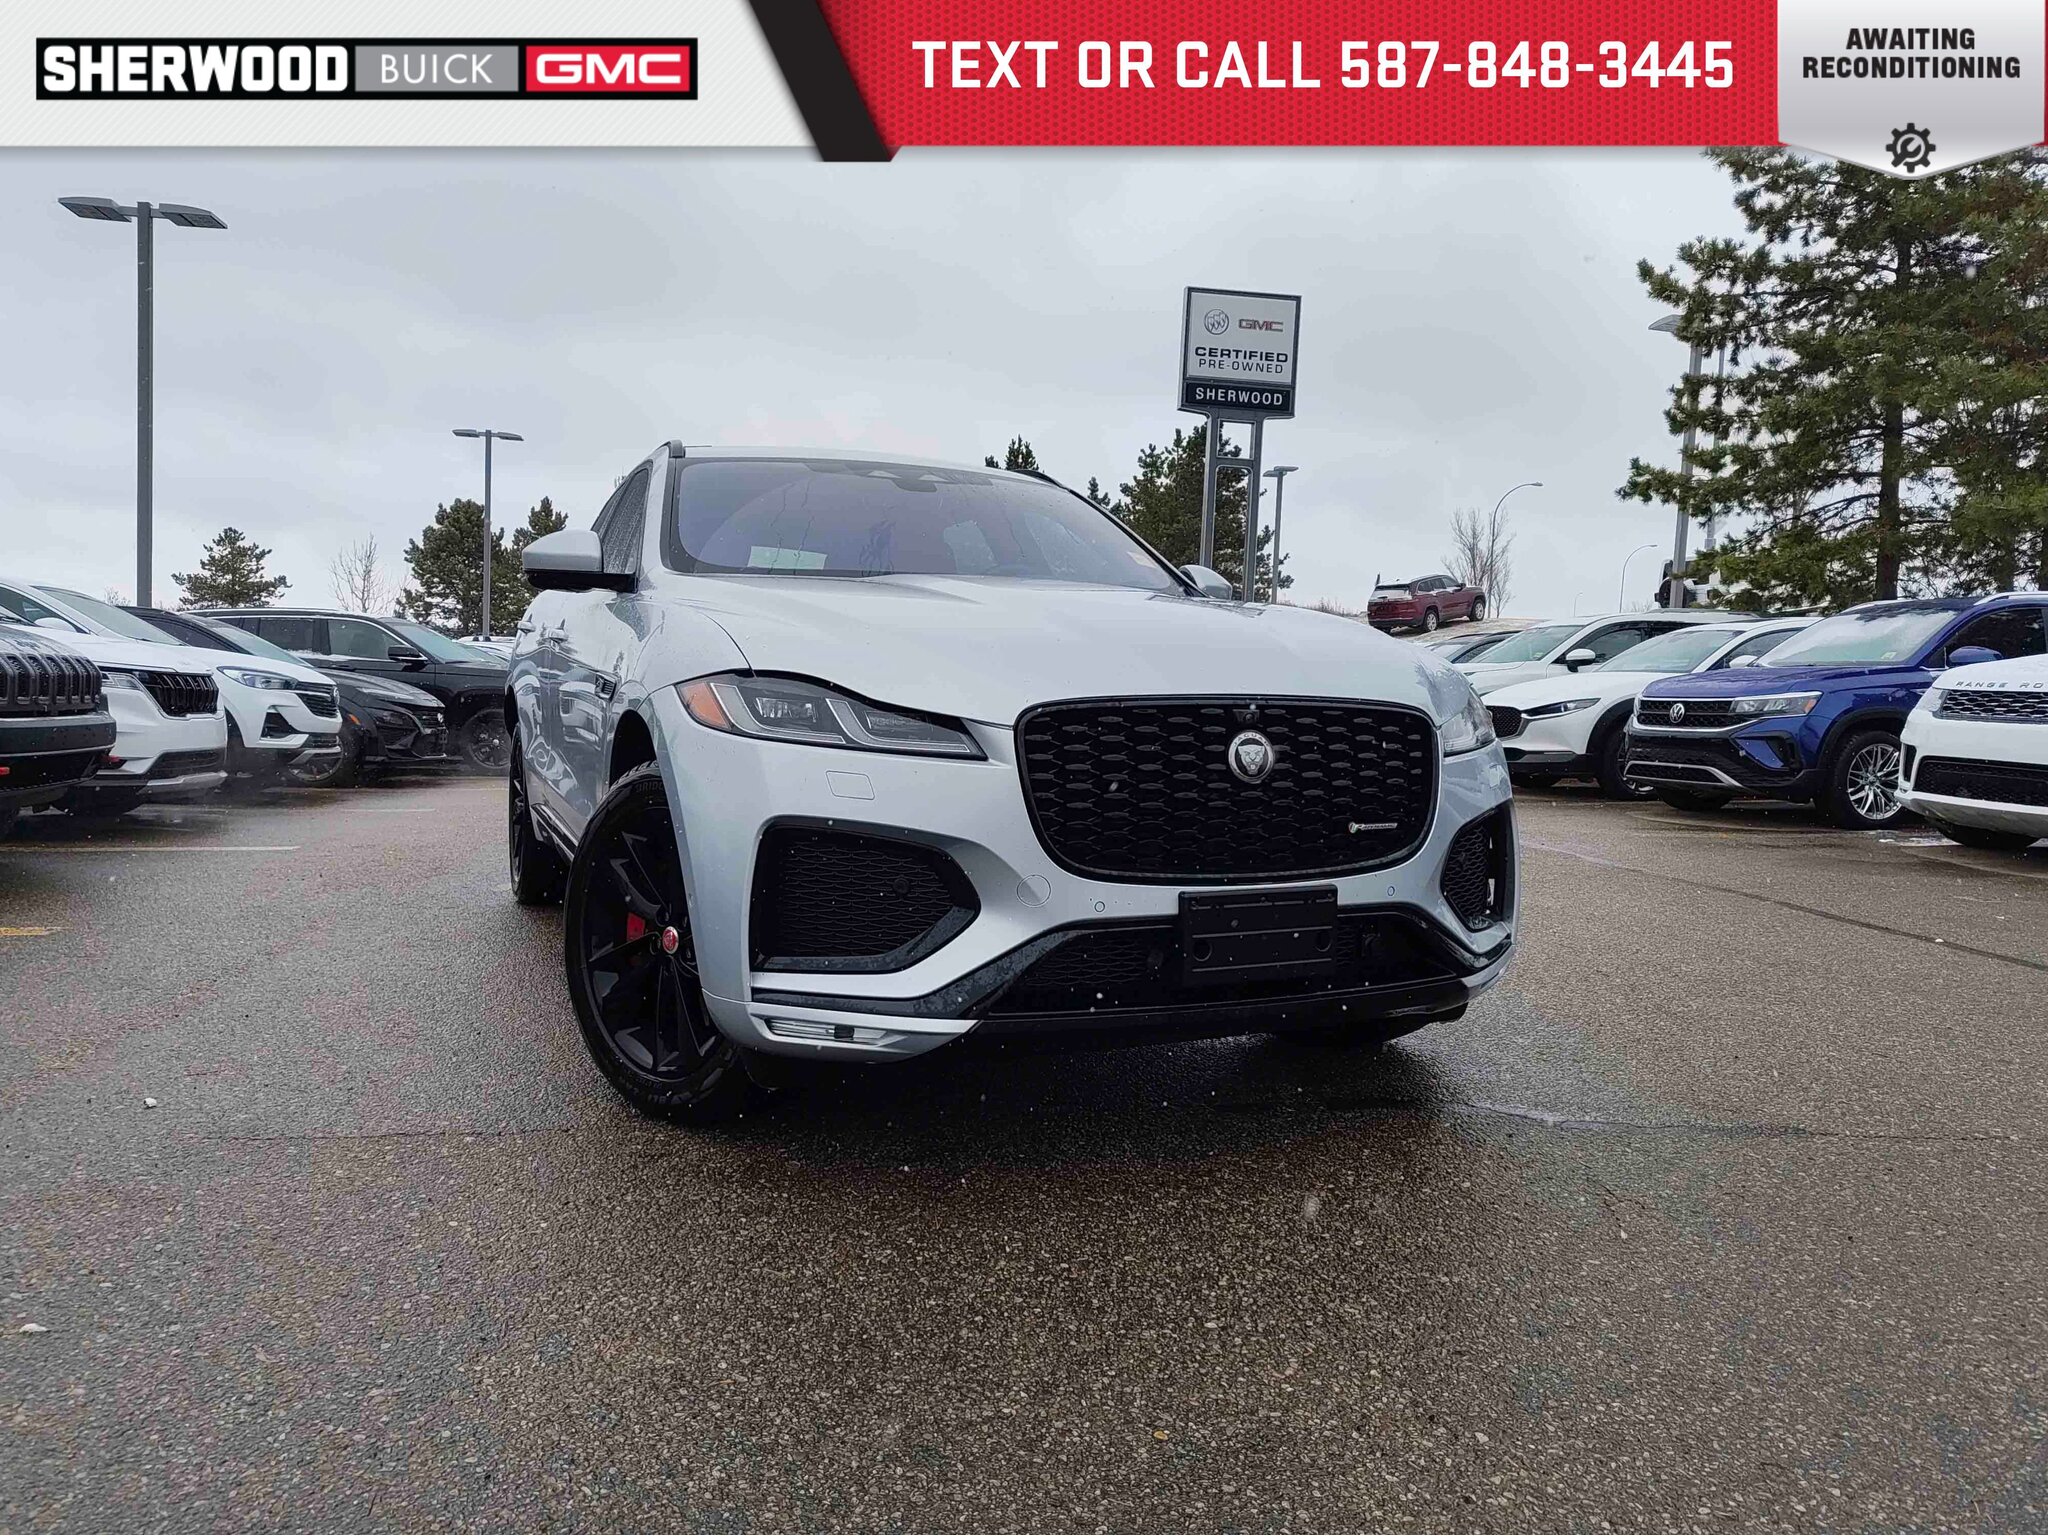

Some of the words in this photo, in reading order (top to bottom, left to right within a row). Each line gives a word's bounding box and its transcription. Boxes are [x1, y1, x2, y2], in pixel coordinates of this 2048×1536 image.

[1238, 318, 1284, 332] GMC
[1194, 346, 1289, 363] CERTIFIED
[1198, 358, 1284, 374] PRE-OWNED
[1195, 387, 1283, 405] SHERWOOD
